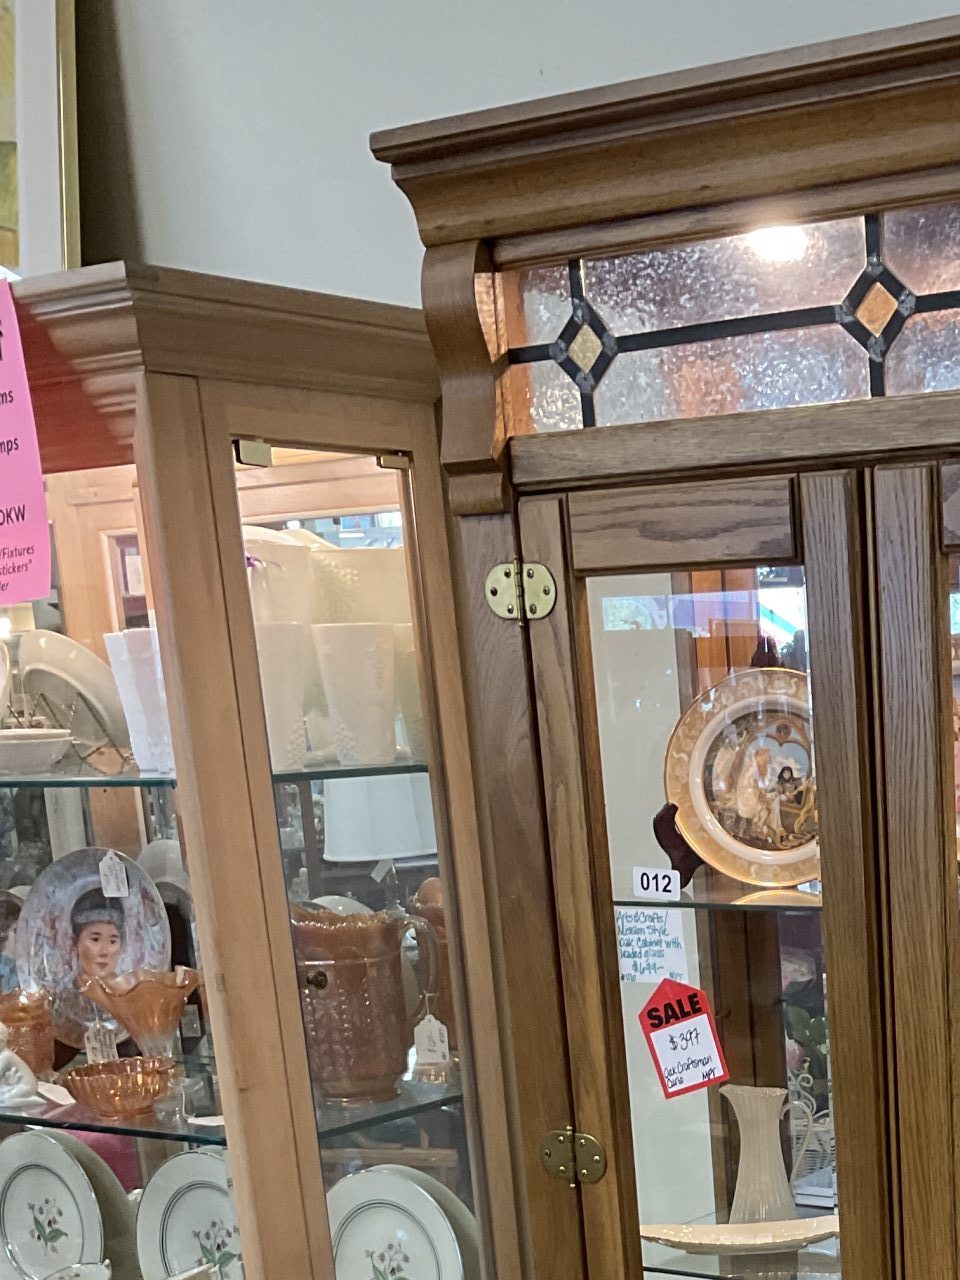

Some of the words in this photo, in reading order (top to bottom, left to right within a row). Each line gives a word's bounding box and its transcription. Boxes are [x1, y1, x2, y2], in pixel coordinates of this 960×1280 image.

[640, 872, 672, 893] 012
[664, 937, 682, 949] with
[646, 992, 703, 1028] SALE
[668, 1027, 700, 1051] $397
[664, 1065, 676, 1079] Oak
[677, 1055, 712, 1074] Craftsman
